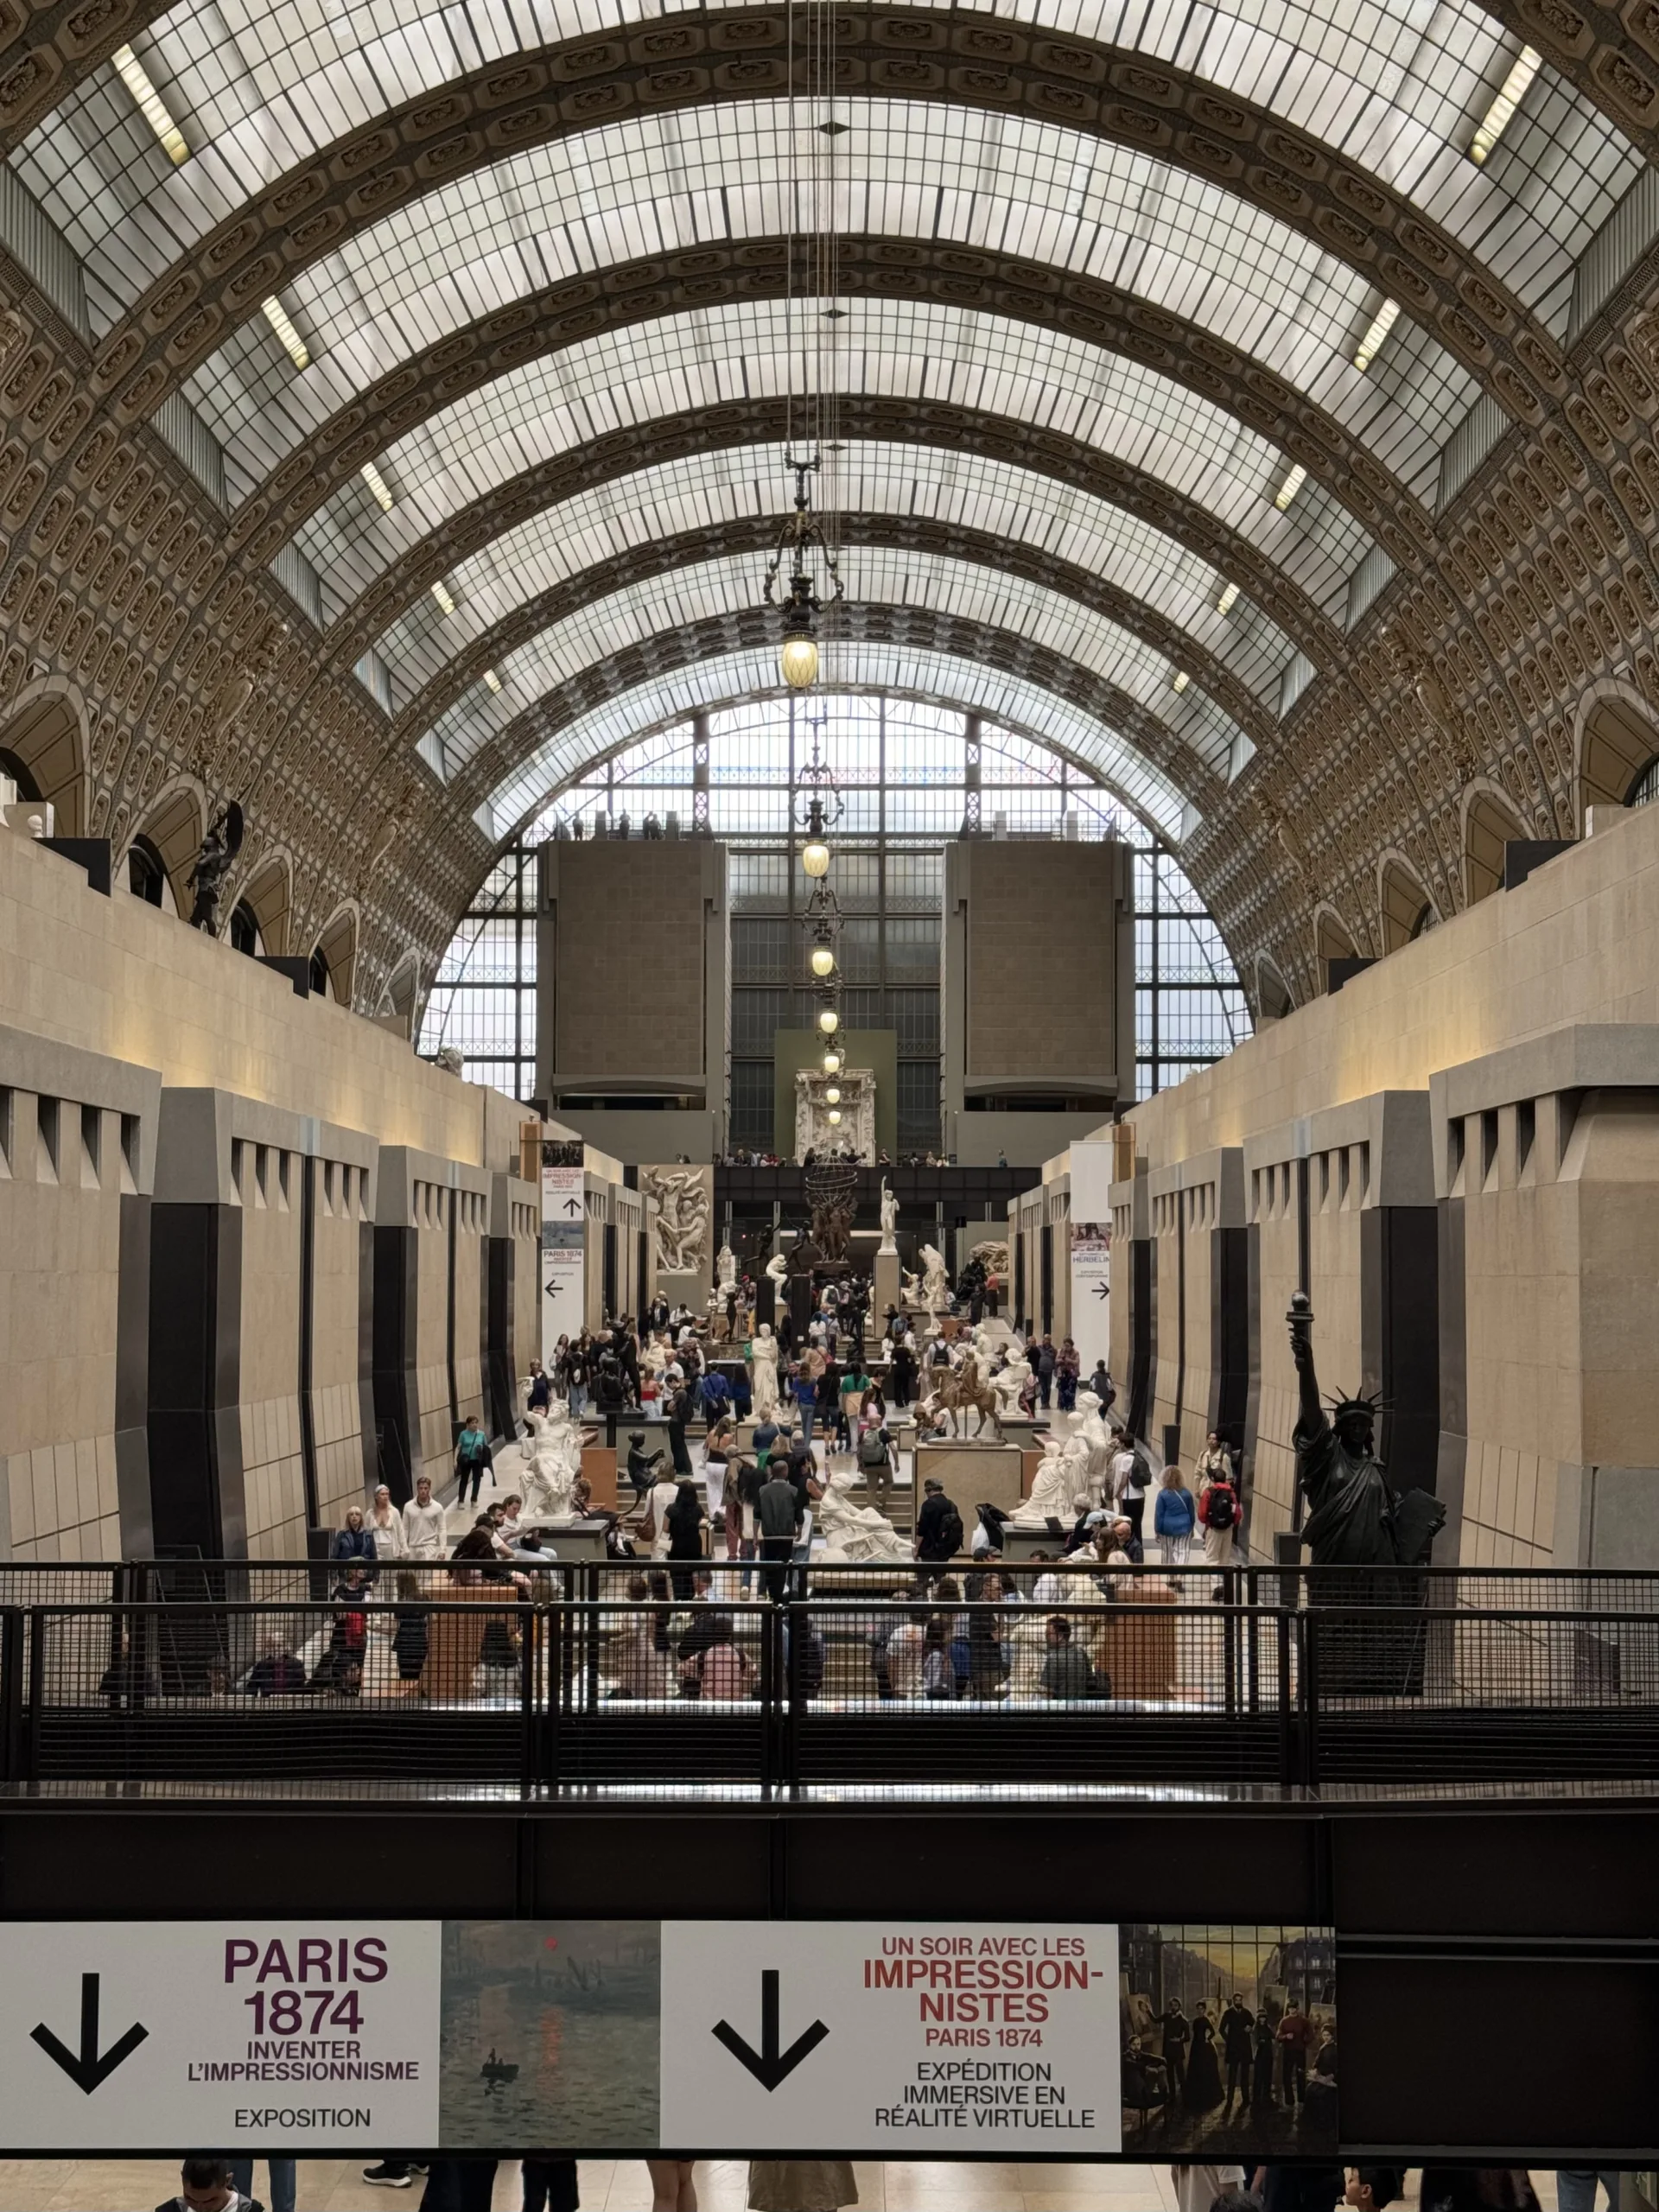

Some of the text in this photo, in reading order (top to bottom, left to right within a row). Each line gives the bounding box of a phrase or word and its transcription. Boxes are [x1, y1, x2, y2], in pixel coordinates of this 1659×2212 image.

[882, 1937, 1084, 1956] UN SOIR AVEC LES
[225, 1938, 388, 1983] PARIS
[865, 1960, 1103, 1989] IMPRESSION-
[245, 1990, 364, 2035] 1874
[920, 1993, 1048, 2023] NISTES
[926, 2029, 1043, 2047] PARIS 1874
[248, 2041, 360, 2059] INVENTER
[188, 2062, 419, 2081] L'IMPRESSIONNISME
[918, 2059, 1051, 2082] EXPÉDITION
[905, 2085, 1065, 2104] IMMERSIVE EN
[235, 2108, 370, 2127] EXPOSITION
[876, 2102, 1095, 2128] RÉALITÉ VIRTUELLE
